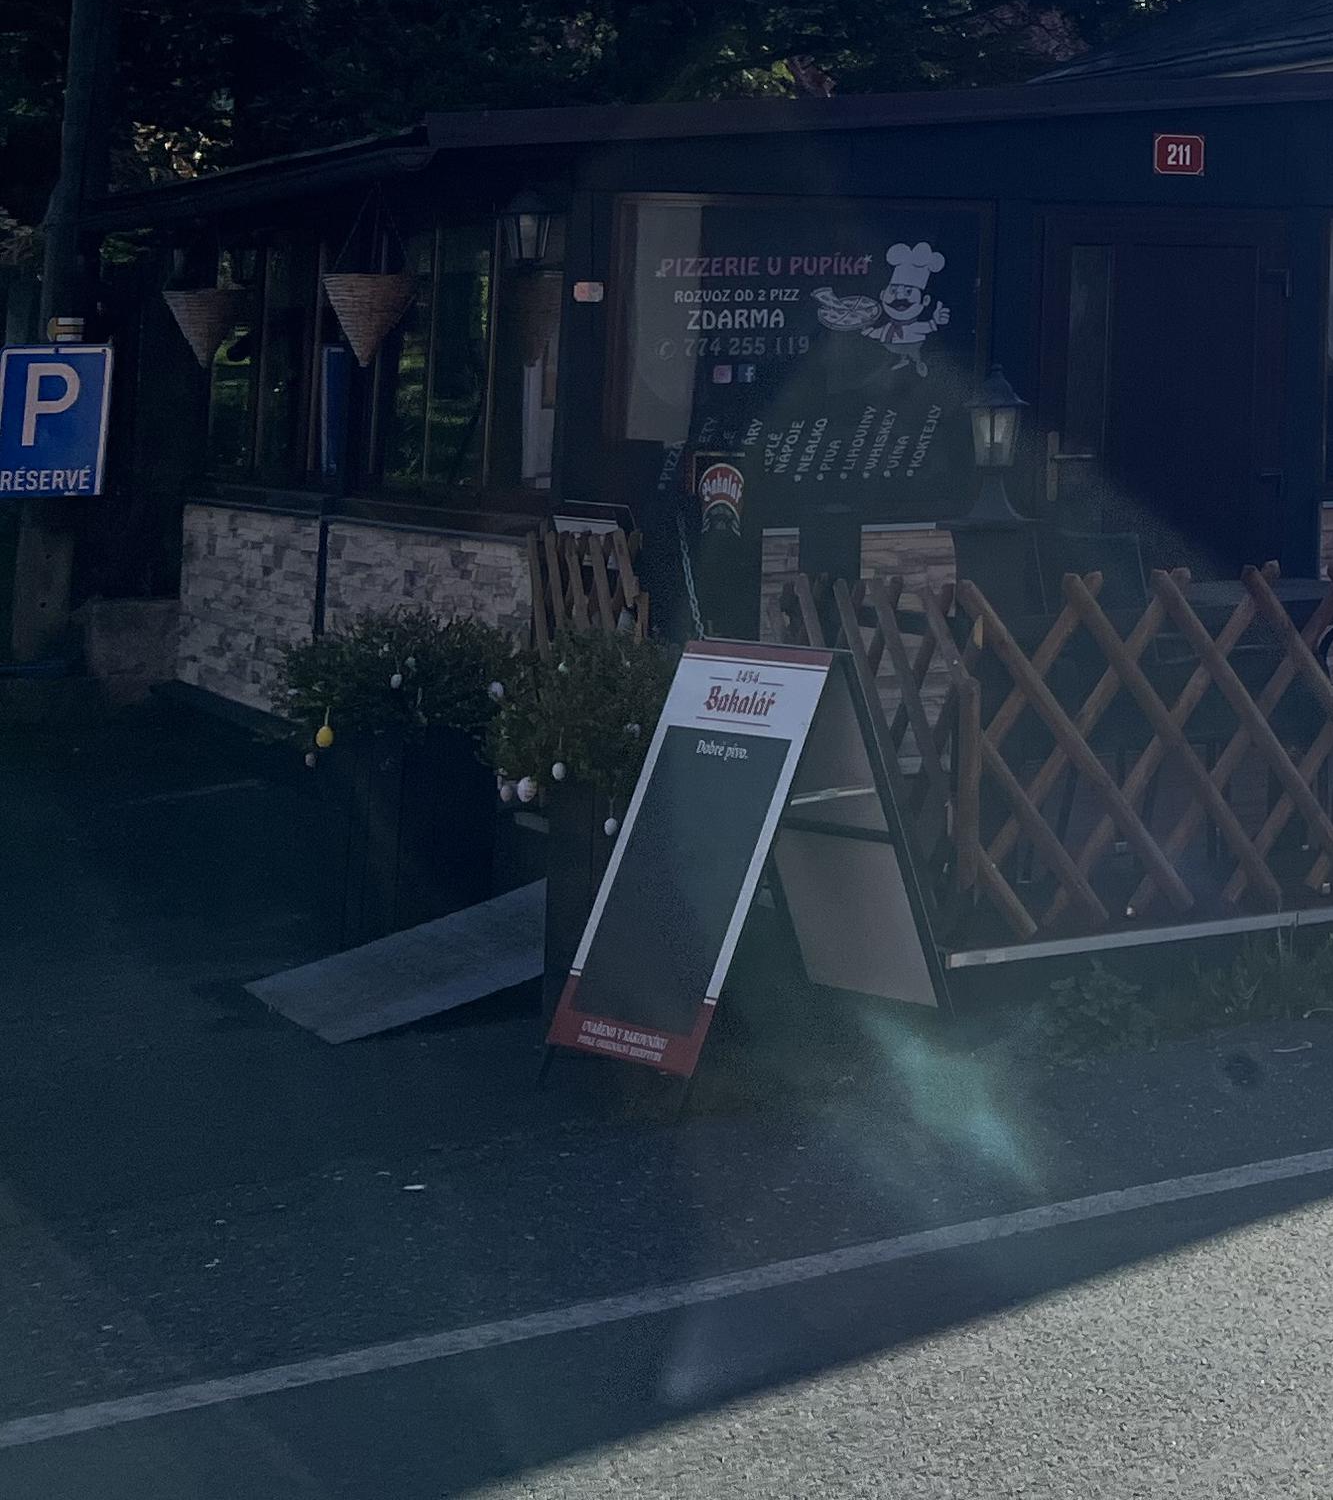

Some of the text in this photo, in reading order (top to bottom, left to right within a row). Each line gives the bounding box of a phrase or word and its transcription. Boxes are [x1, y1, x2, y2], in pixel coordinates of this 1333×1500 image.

[1167, 144, 1191, 165] 211
[660, 252, 869, 277] PIZZERIE U PUPÍKA
[674, 289, 731, 303] ROZVOZ
[736, 289, 754, 301] OD
[758, 289, 766, 301] 2
[686, 308, 785, 330] ZDARMA
[683, 335, 809, 357] 774 255 119
[21, 363, 80, 446] P
[797, 417, 828, 472] NEALKO
[843, 404, 877, 470] LIHOVINY
[864, 408, 897, 471] WHISKEY
[909, 403, 942, 468] KOKTEJLY
[820, 438, 842, 471] PIVA
[0, 464, 91, 491] RÉSERVÉ
[703, 685, 776, 716] Bakalář
